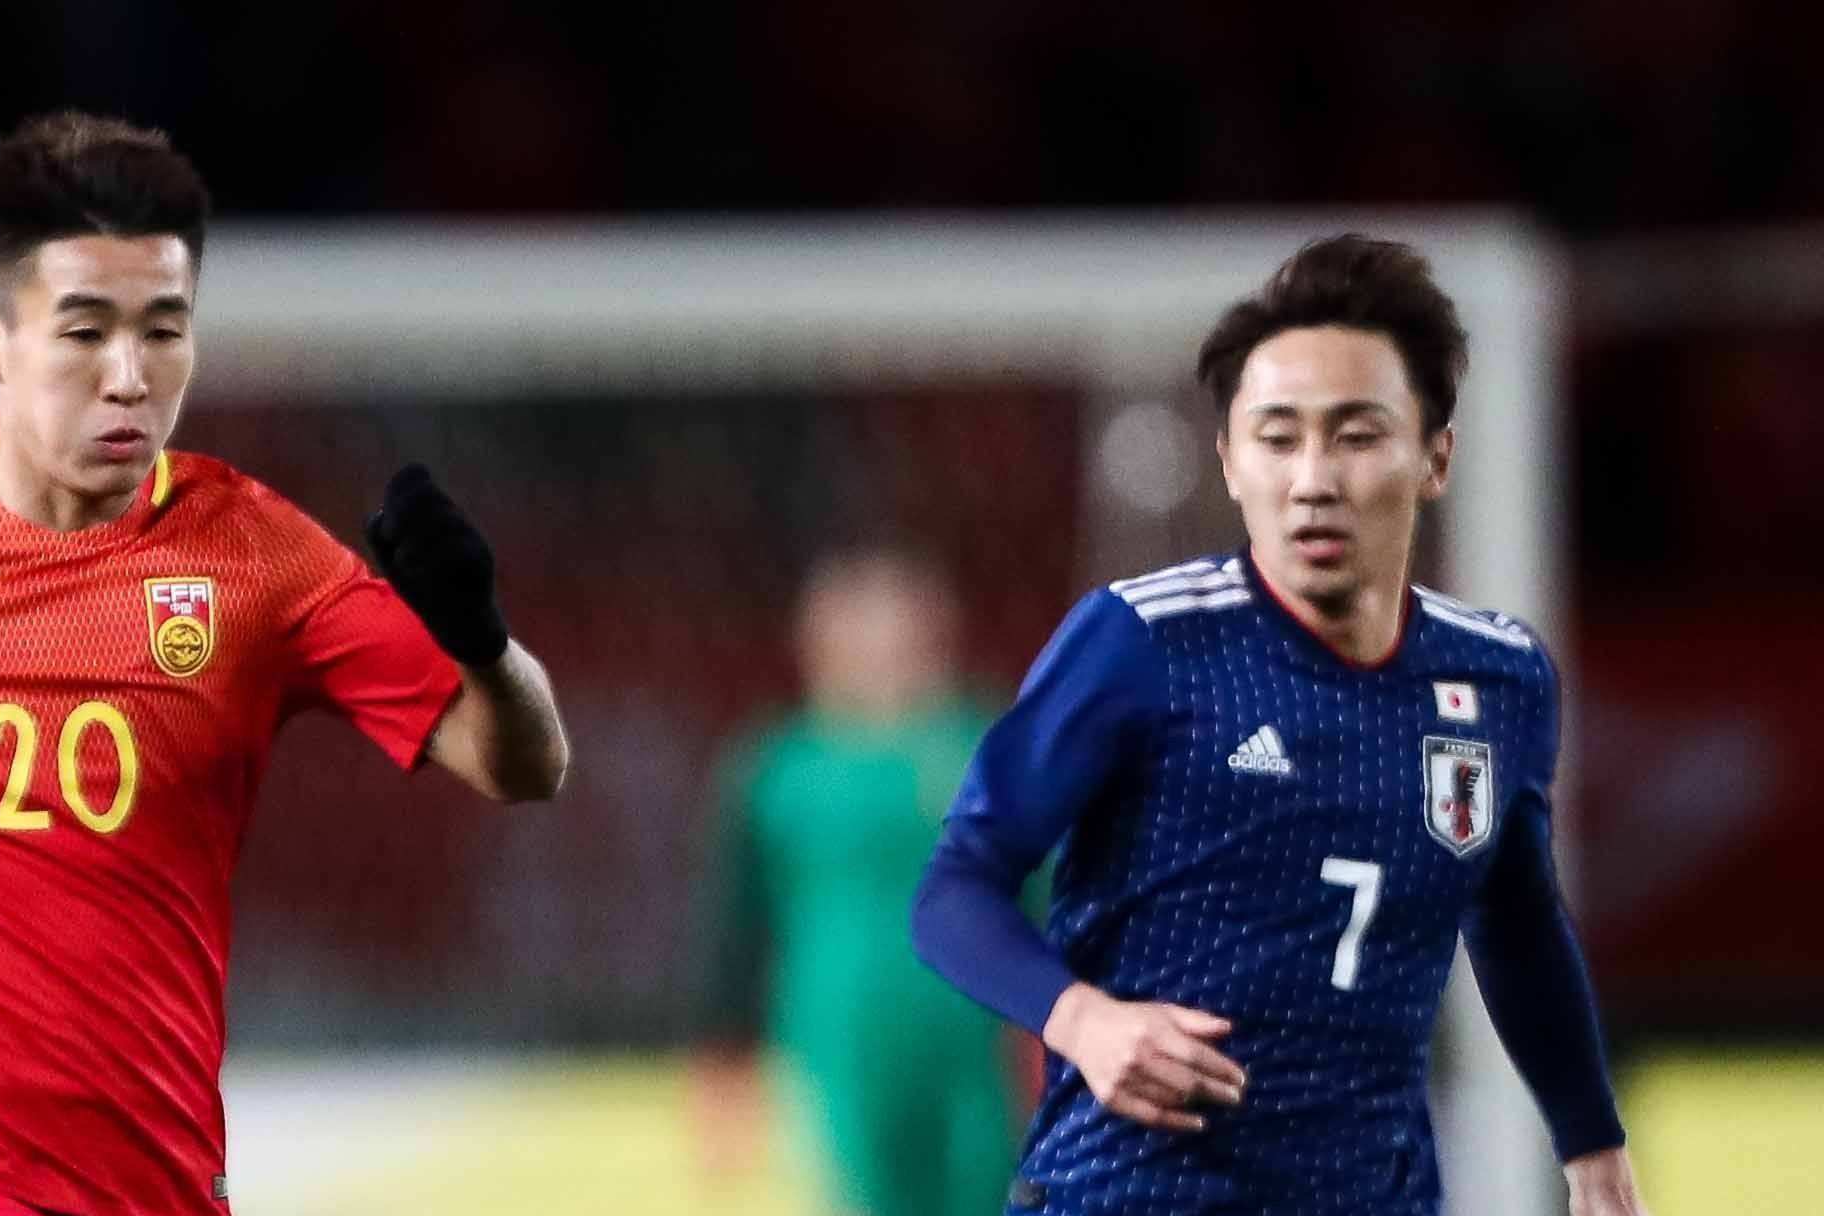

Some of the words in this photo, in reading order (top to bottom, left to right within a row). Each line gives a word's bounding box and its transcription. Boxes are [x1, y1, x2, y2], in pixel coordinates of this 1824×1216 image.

[151, 584, 207, 603] CFA
[1227, 751, 1292, 775] adidas
[1320, 857, 1382, 991] 7
